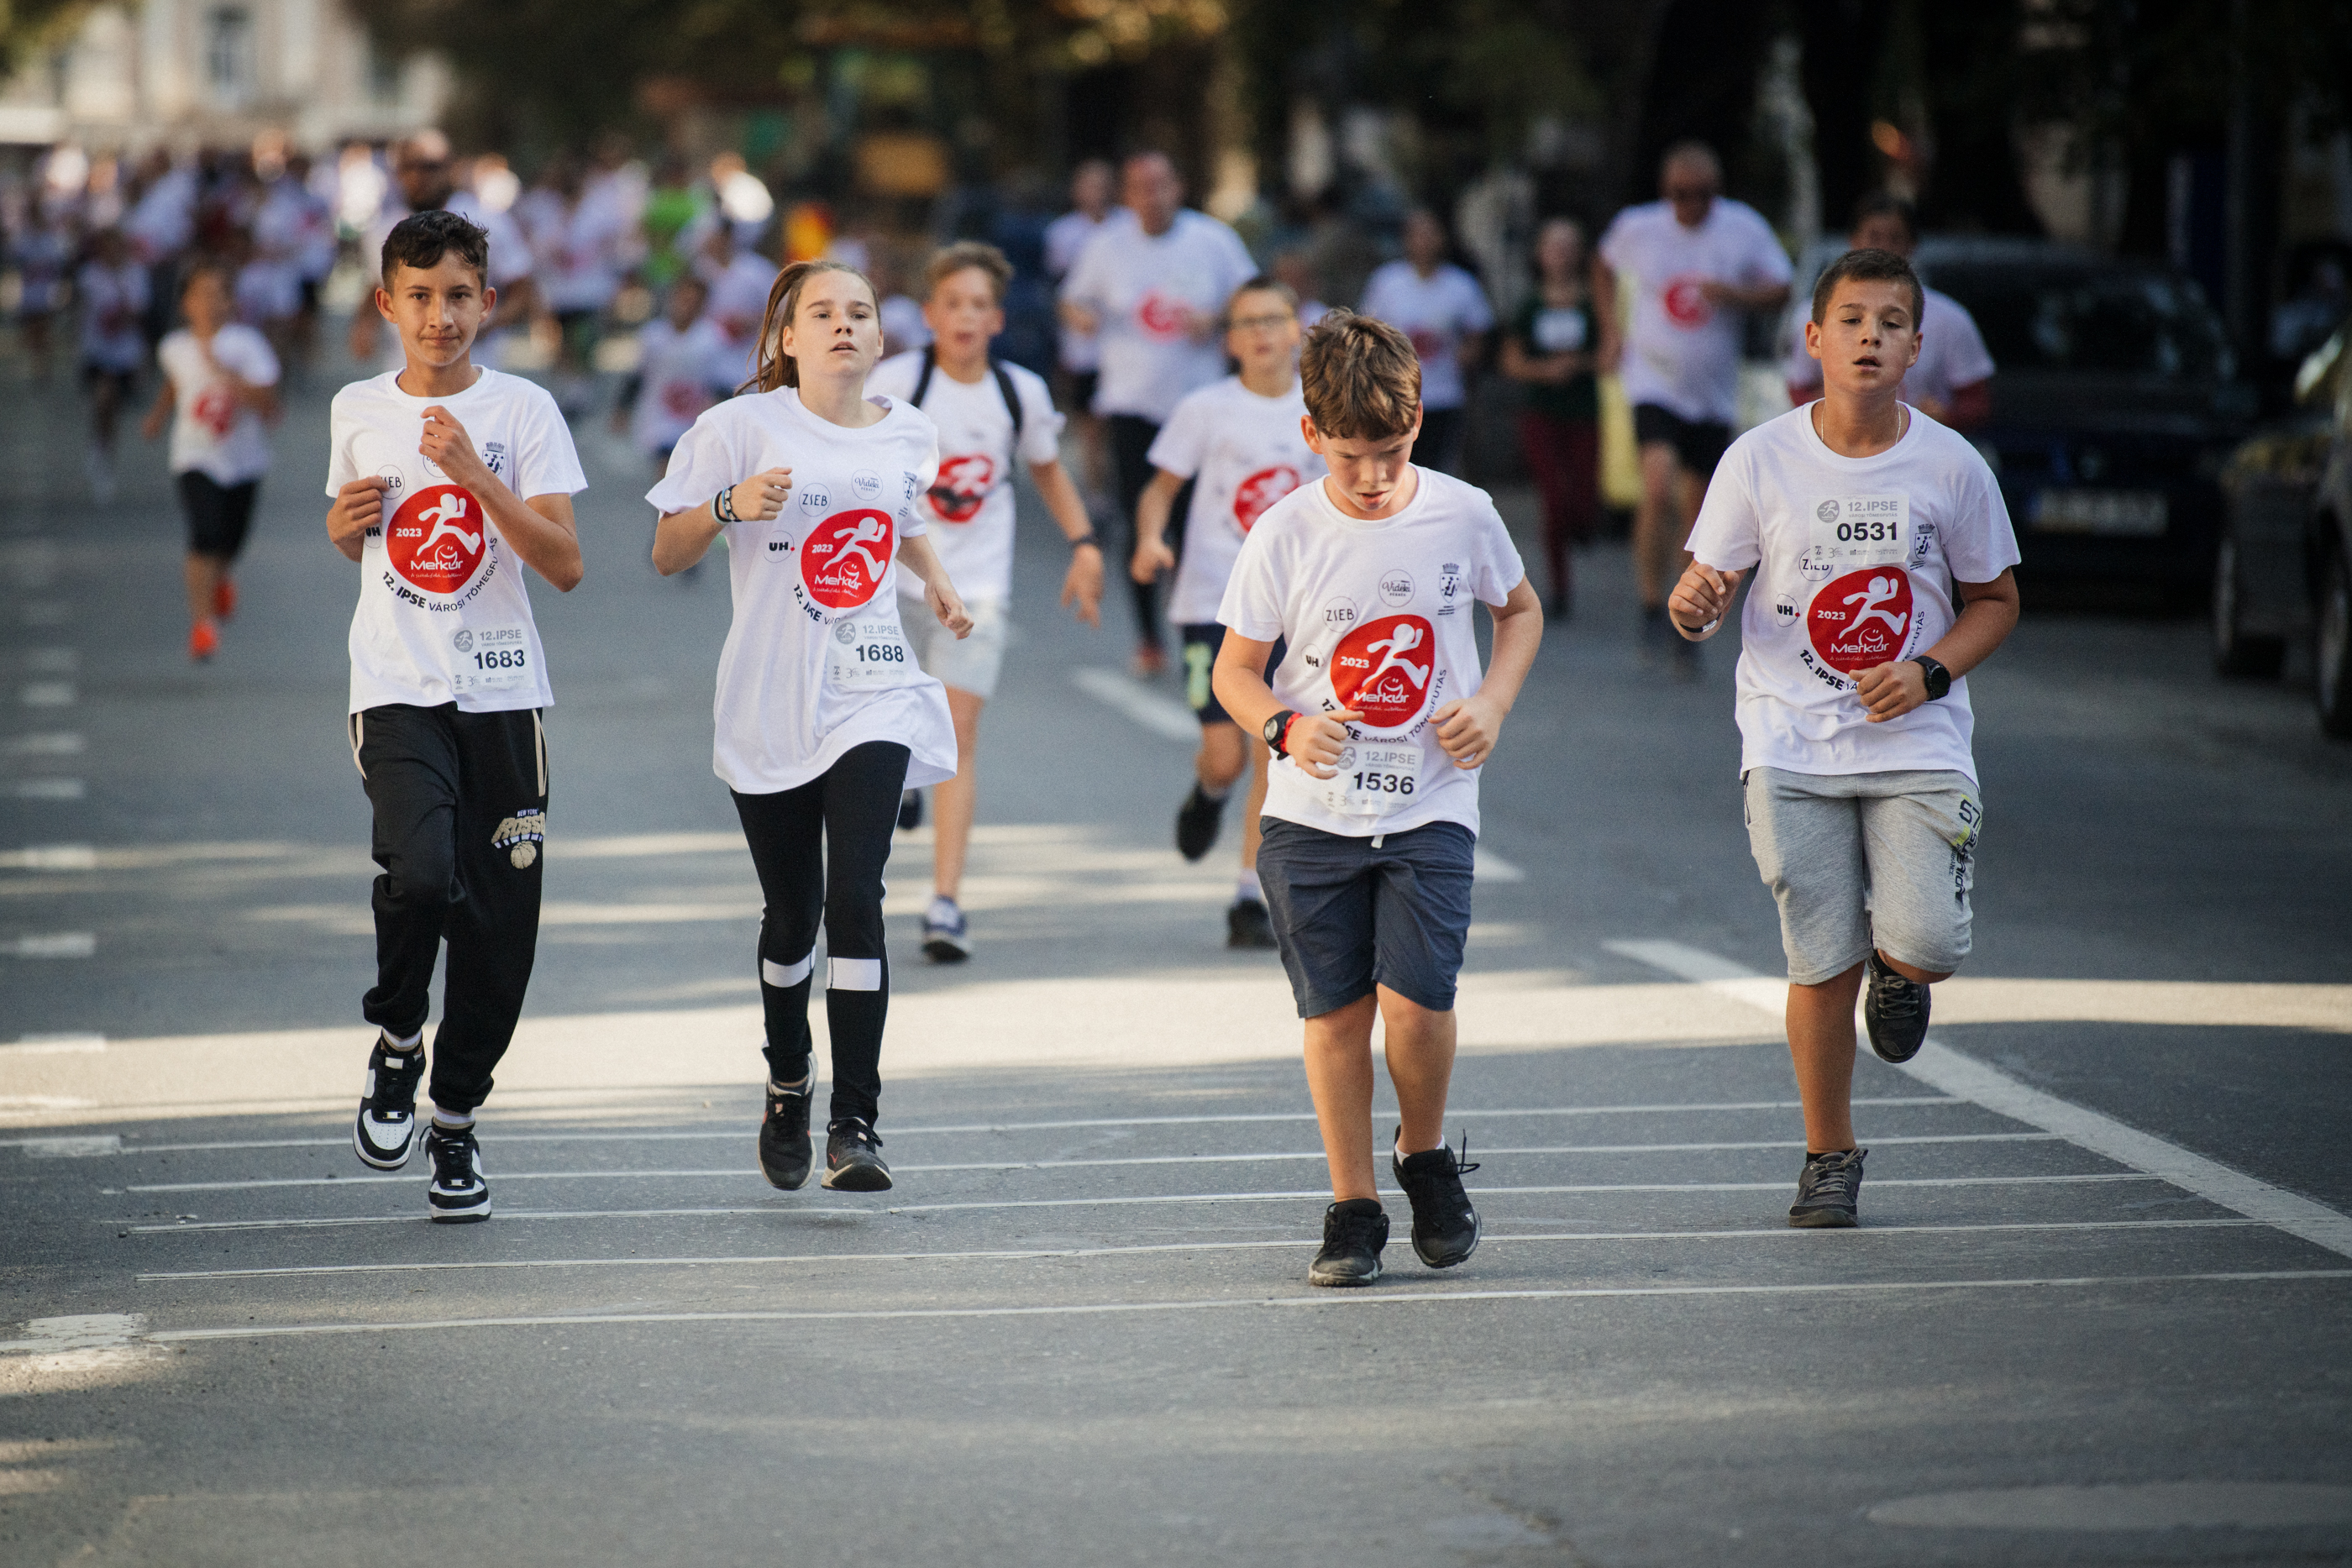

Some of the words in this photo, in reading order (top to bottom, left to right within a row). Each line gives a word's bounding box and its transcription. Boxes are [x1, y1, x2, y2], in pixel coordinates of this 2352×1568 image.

[396, 527, 423, 538] 2023
[1836, 522, 1897, 542] 0531
[811, 543, 834, 553] 2023
[382, 571, 395, 591] 12.
[396, 586, 427, 609] IPSE
[428, 599, 465, 612] VÁROSI
[793, 584, 804, 605] 12.
[1817, 610, 1846, 621] 2023
[474, 649, 525, 669] 1683
[855, 643, 904, 663] 1688
[1340, 656, 1370, 669] 2023
[1799, 649, 1814, 670] 12.
[1814, 666, 1845, 691] IPSE
[1364, 735, 1408, 743] VÁROSI
[1353, 771, 1415, 794] 1536
[517, 810, 527, 818] NEW
